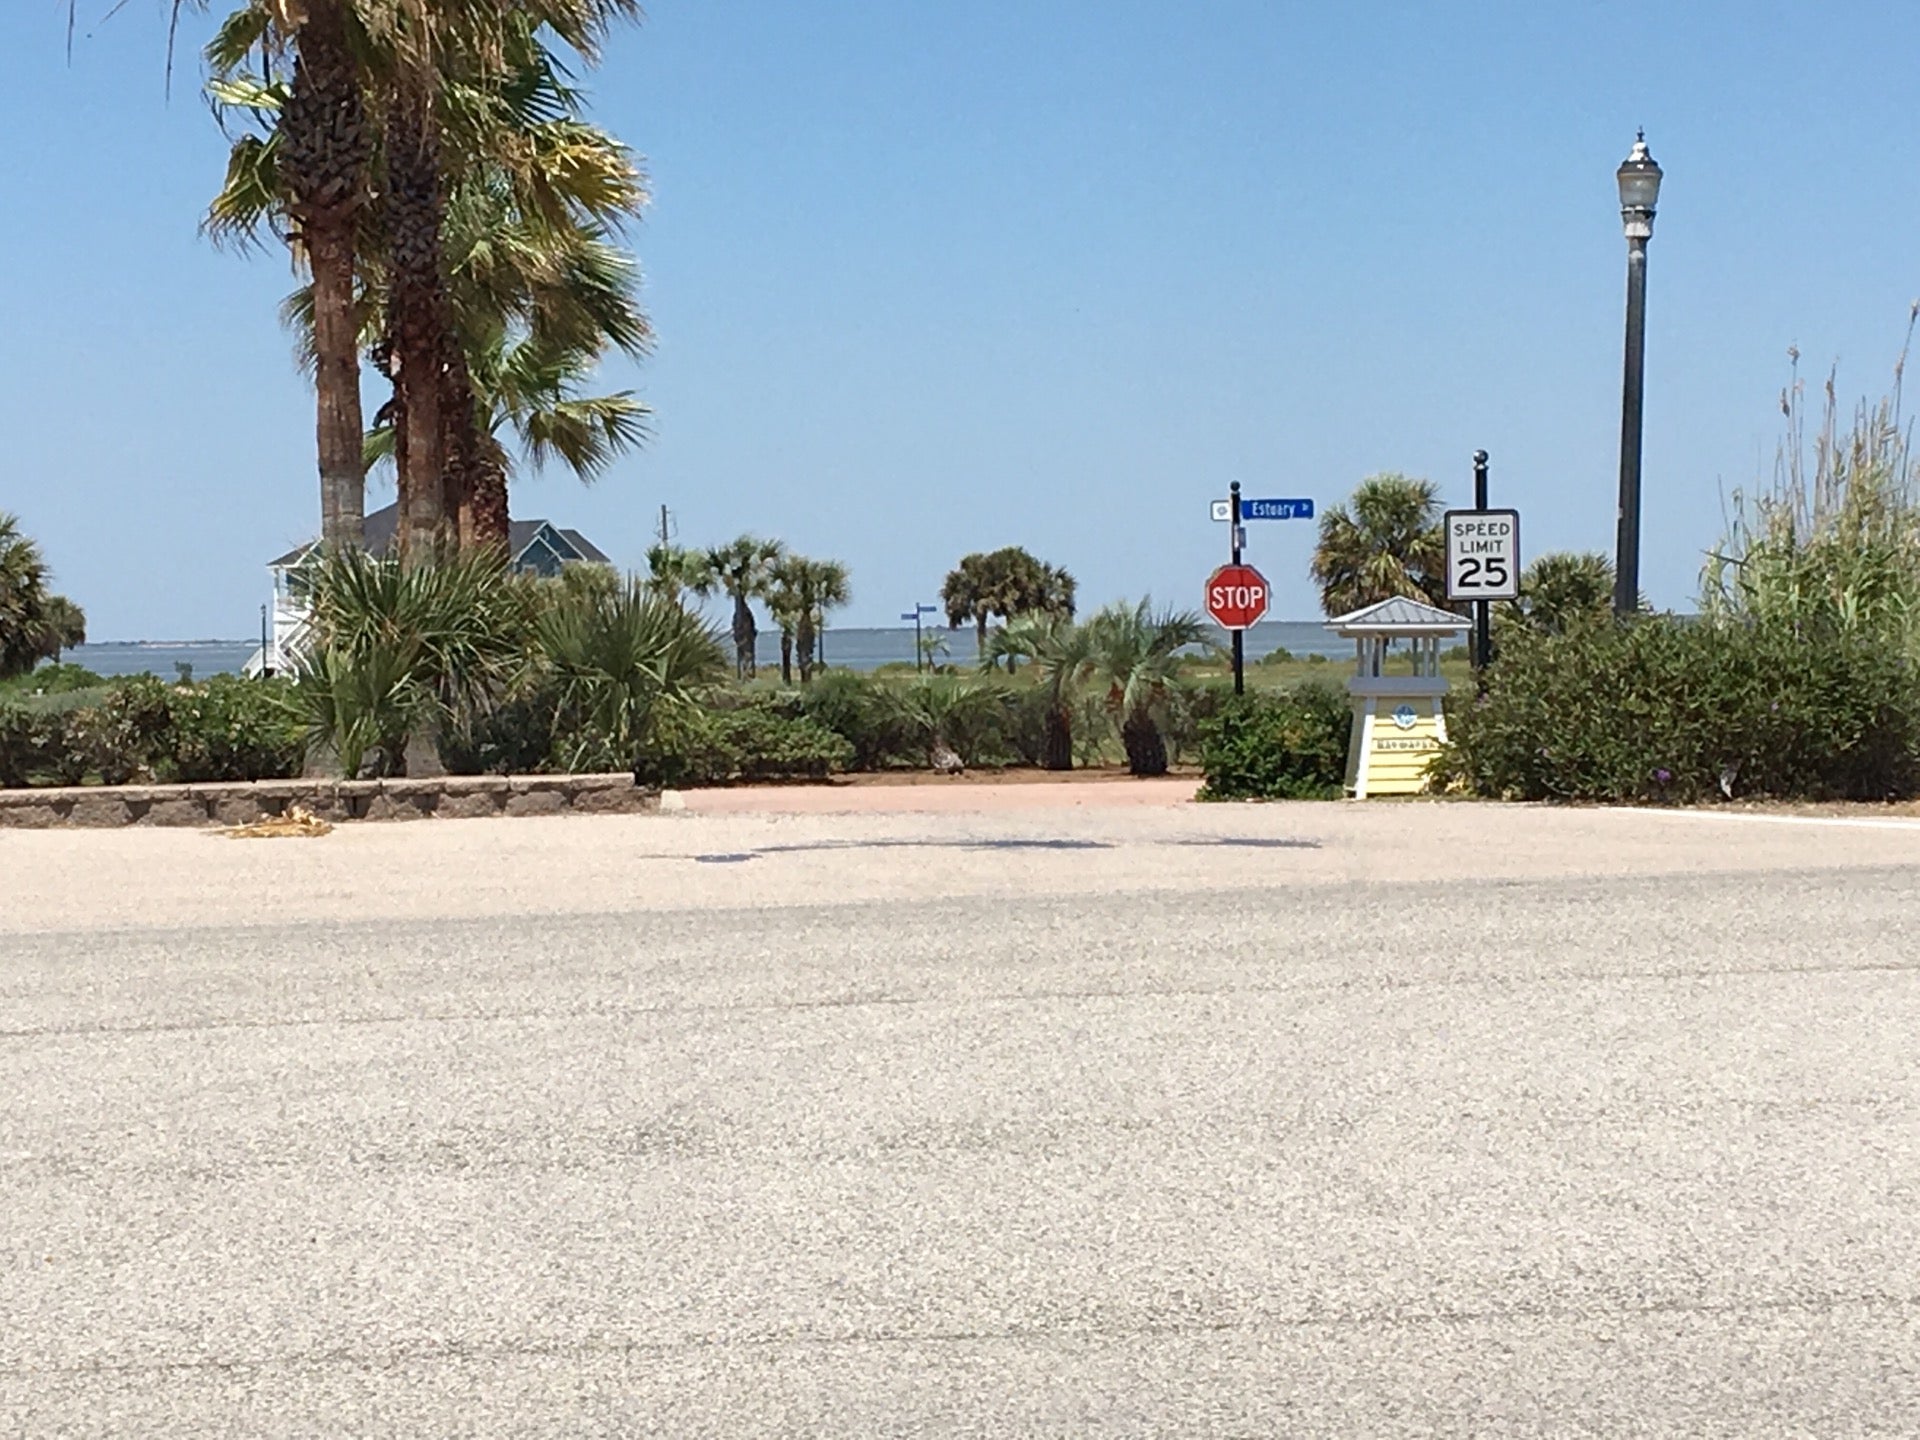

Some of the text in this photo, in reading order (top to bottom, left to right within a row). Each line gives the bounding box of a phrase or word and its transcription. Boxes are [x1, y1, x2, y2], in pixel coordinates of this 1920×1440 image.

[1252, 502, 1296, 518] Estuary
[1454, 522, 1510, 537] SPEED
[1460, 540, 1503, 553] LIMIT
[1458, 557, 1508, 588] 25
[1211, 586, 1263, 609] STOP
